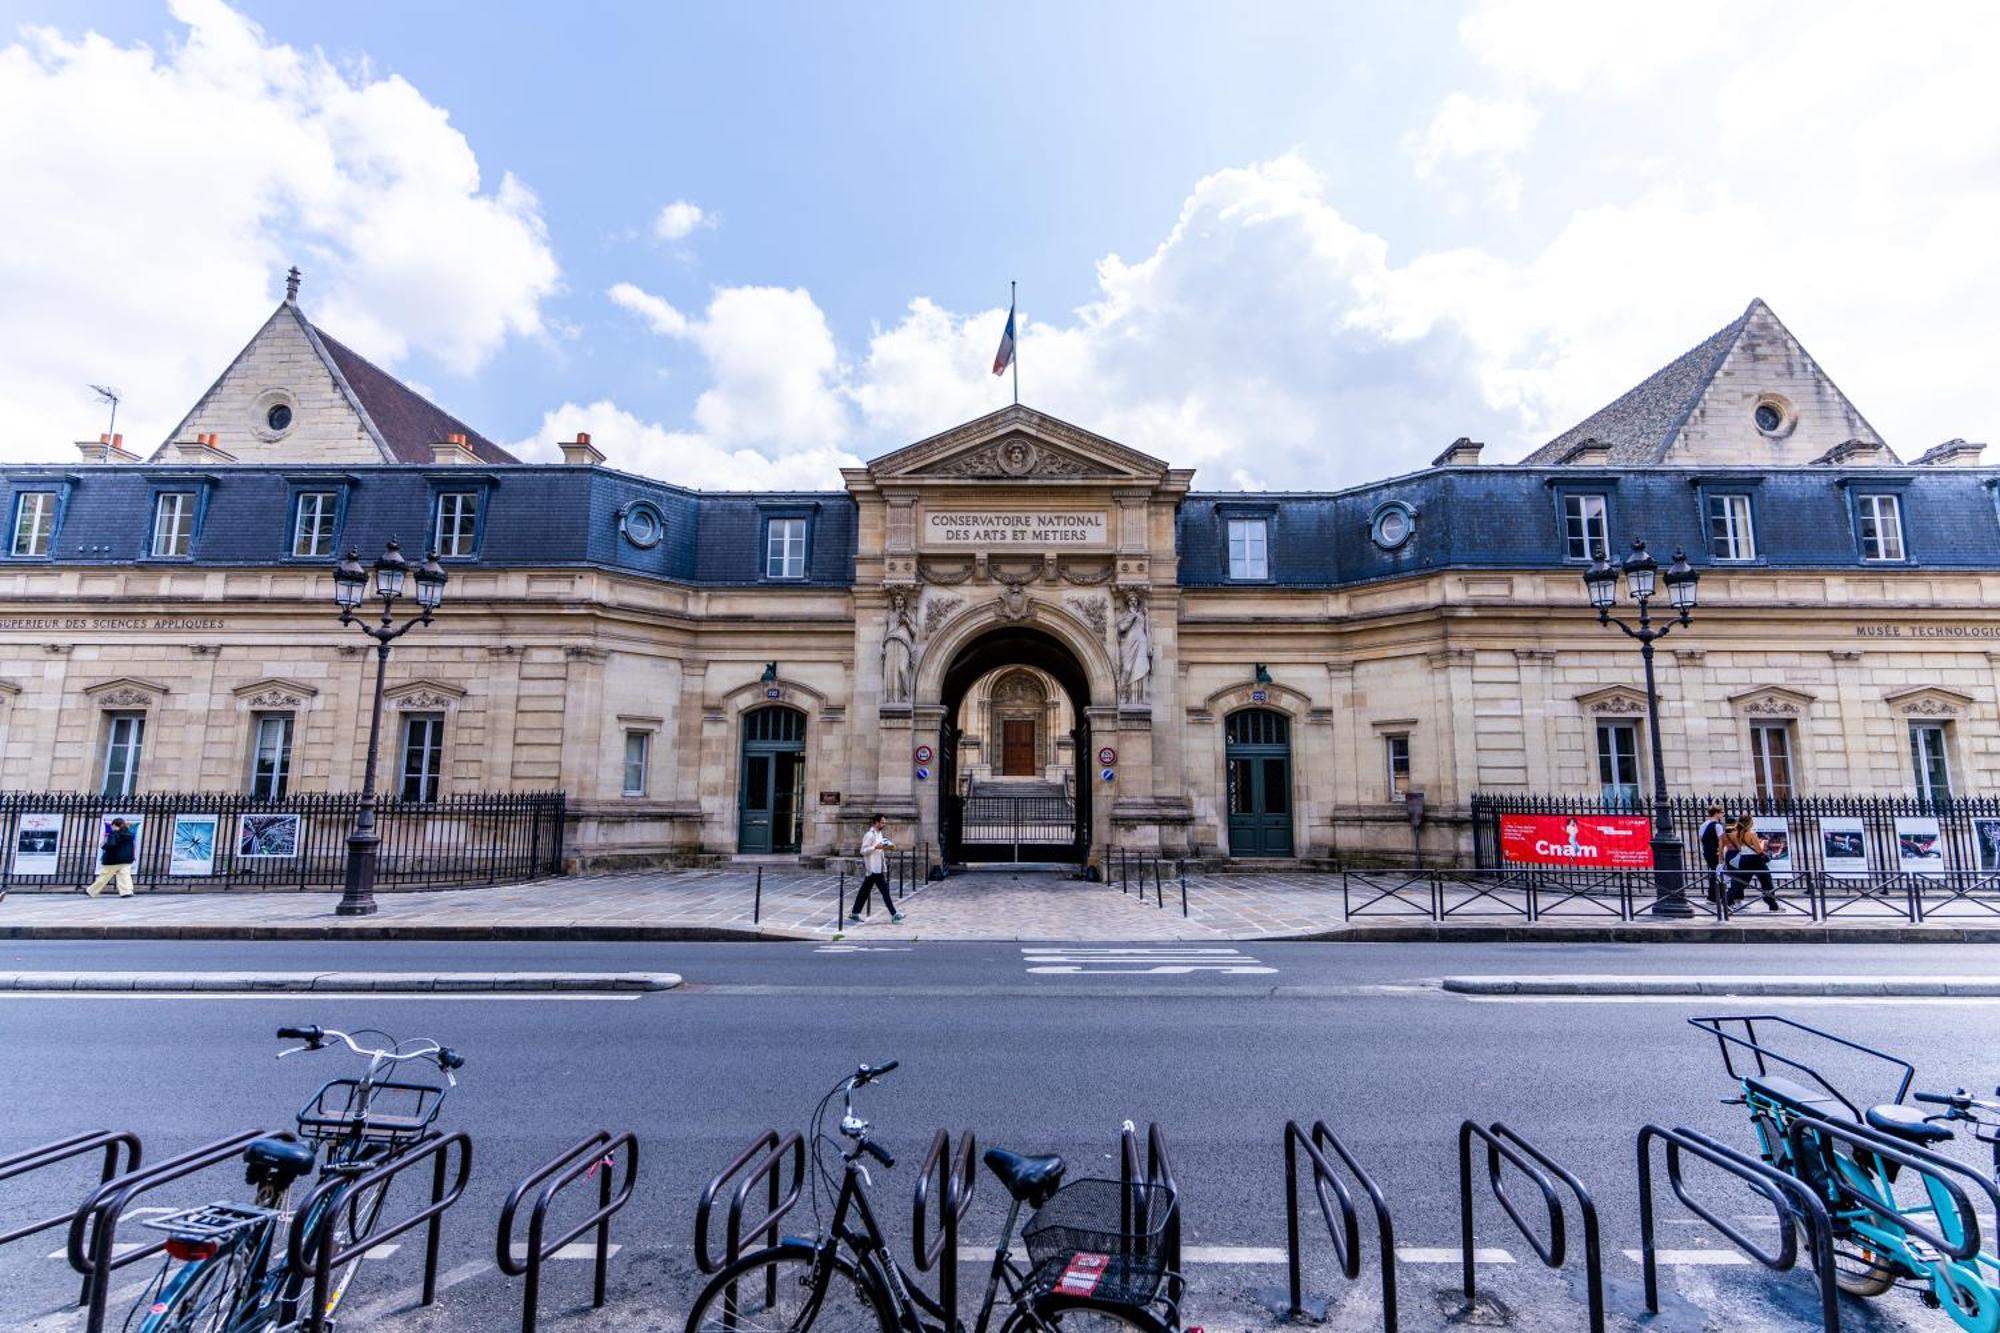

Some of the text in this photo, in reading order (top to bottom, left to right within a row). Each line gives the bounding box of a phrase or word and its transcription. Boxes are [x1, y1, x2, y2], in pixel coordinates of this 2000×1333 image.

[931, 515, 1102, 526] CONSERVATOIRE NATIONAL
[946, 530, 1087, 540] DES ARTS ET METIERS
[65, 619, 87, 629] DES
[93, 619, 147, 629] SCIENCES
[1857, 624, 1901, 637] MUSÉE
[1535, 840, 1598, 858] Cnam
